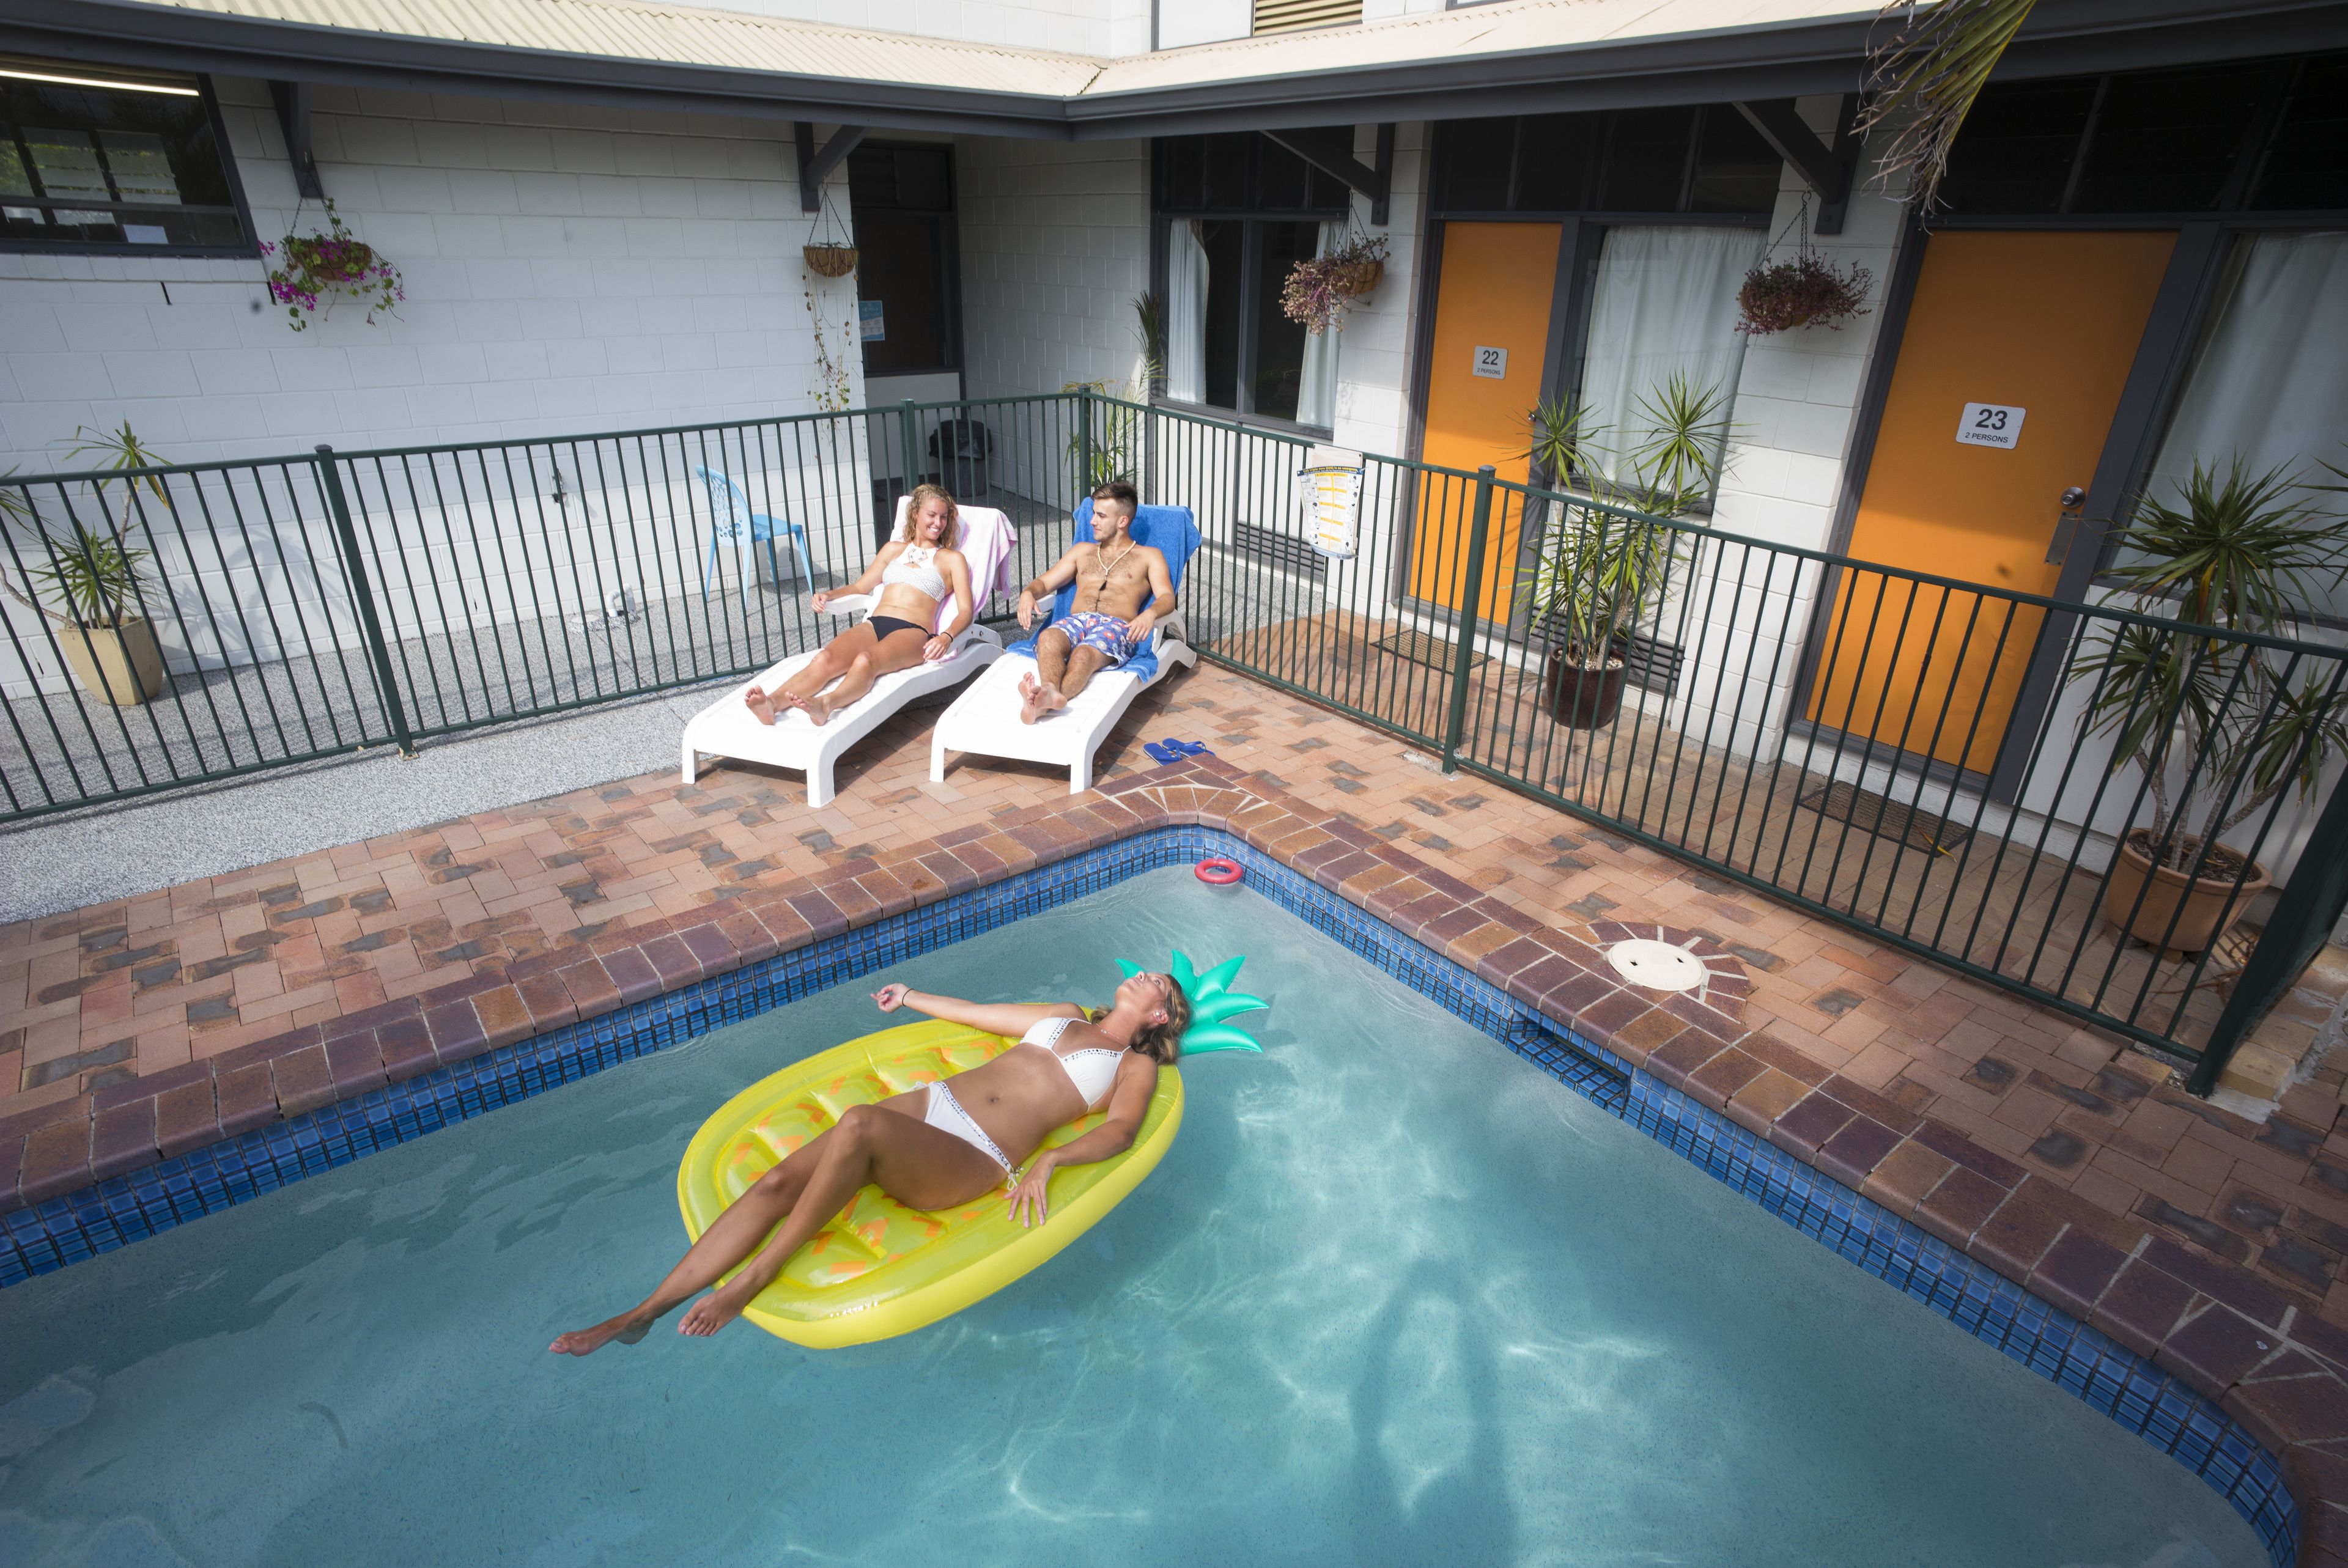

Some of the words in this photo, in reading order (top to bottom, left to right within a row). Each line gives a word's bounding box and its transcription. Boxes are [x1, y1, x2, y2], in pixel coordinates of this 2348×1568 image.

[1482, 350, 1499, 366] 22
[1975, 408, 2008, 430] 23
[1971, 433, 2009, 443] PERSONS
